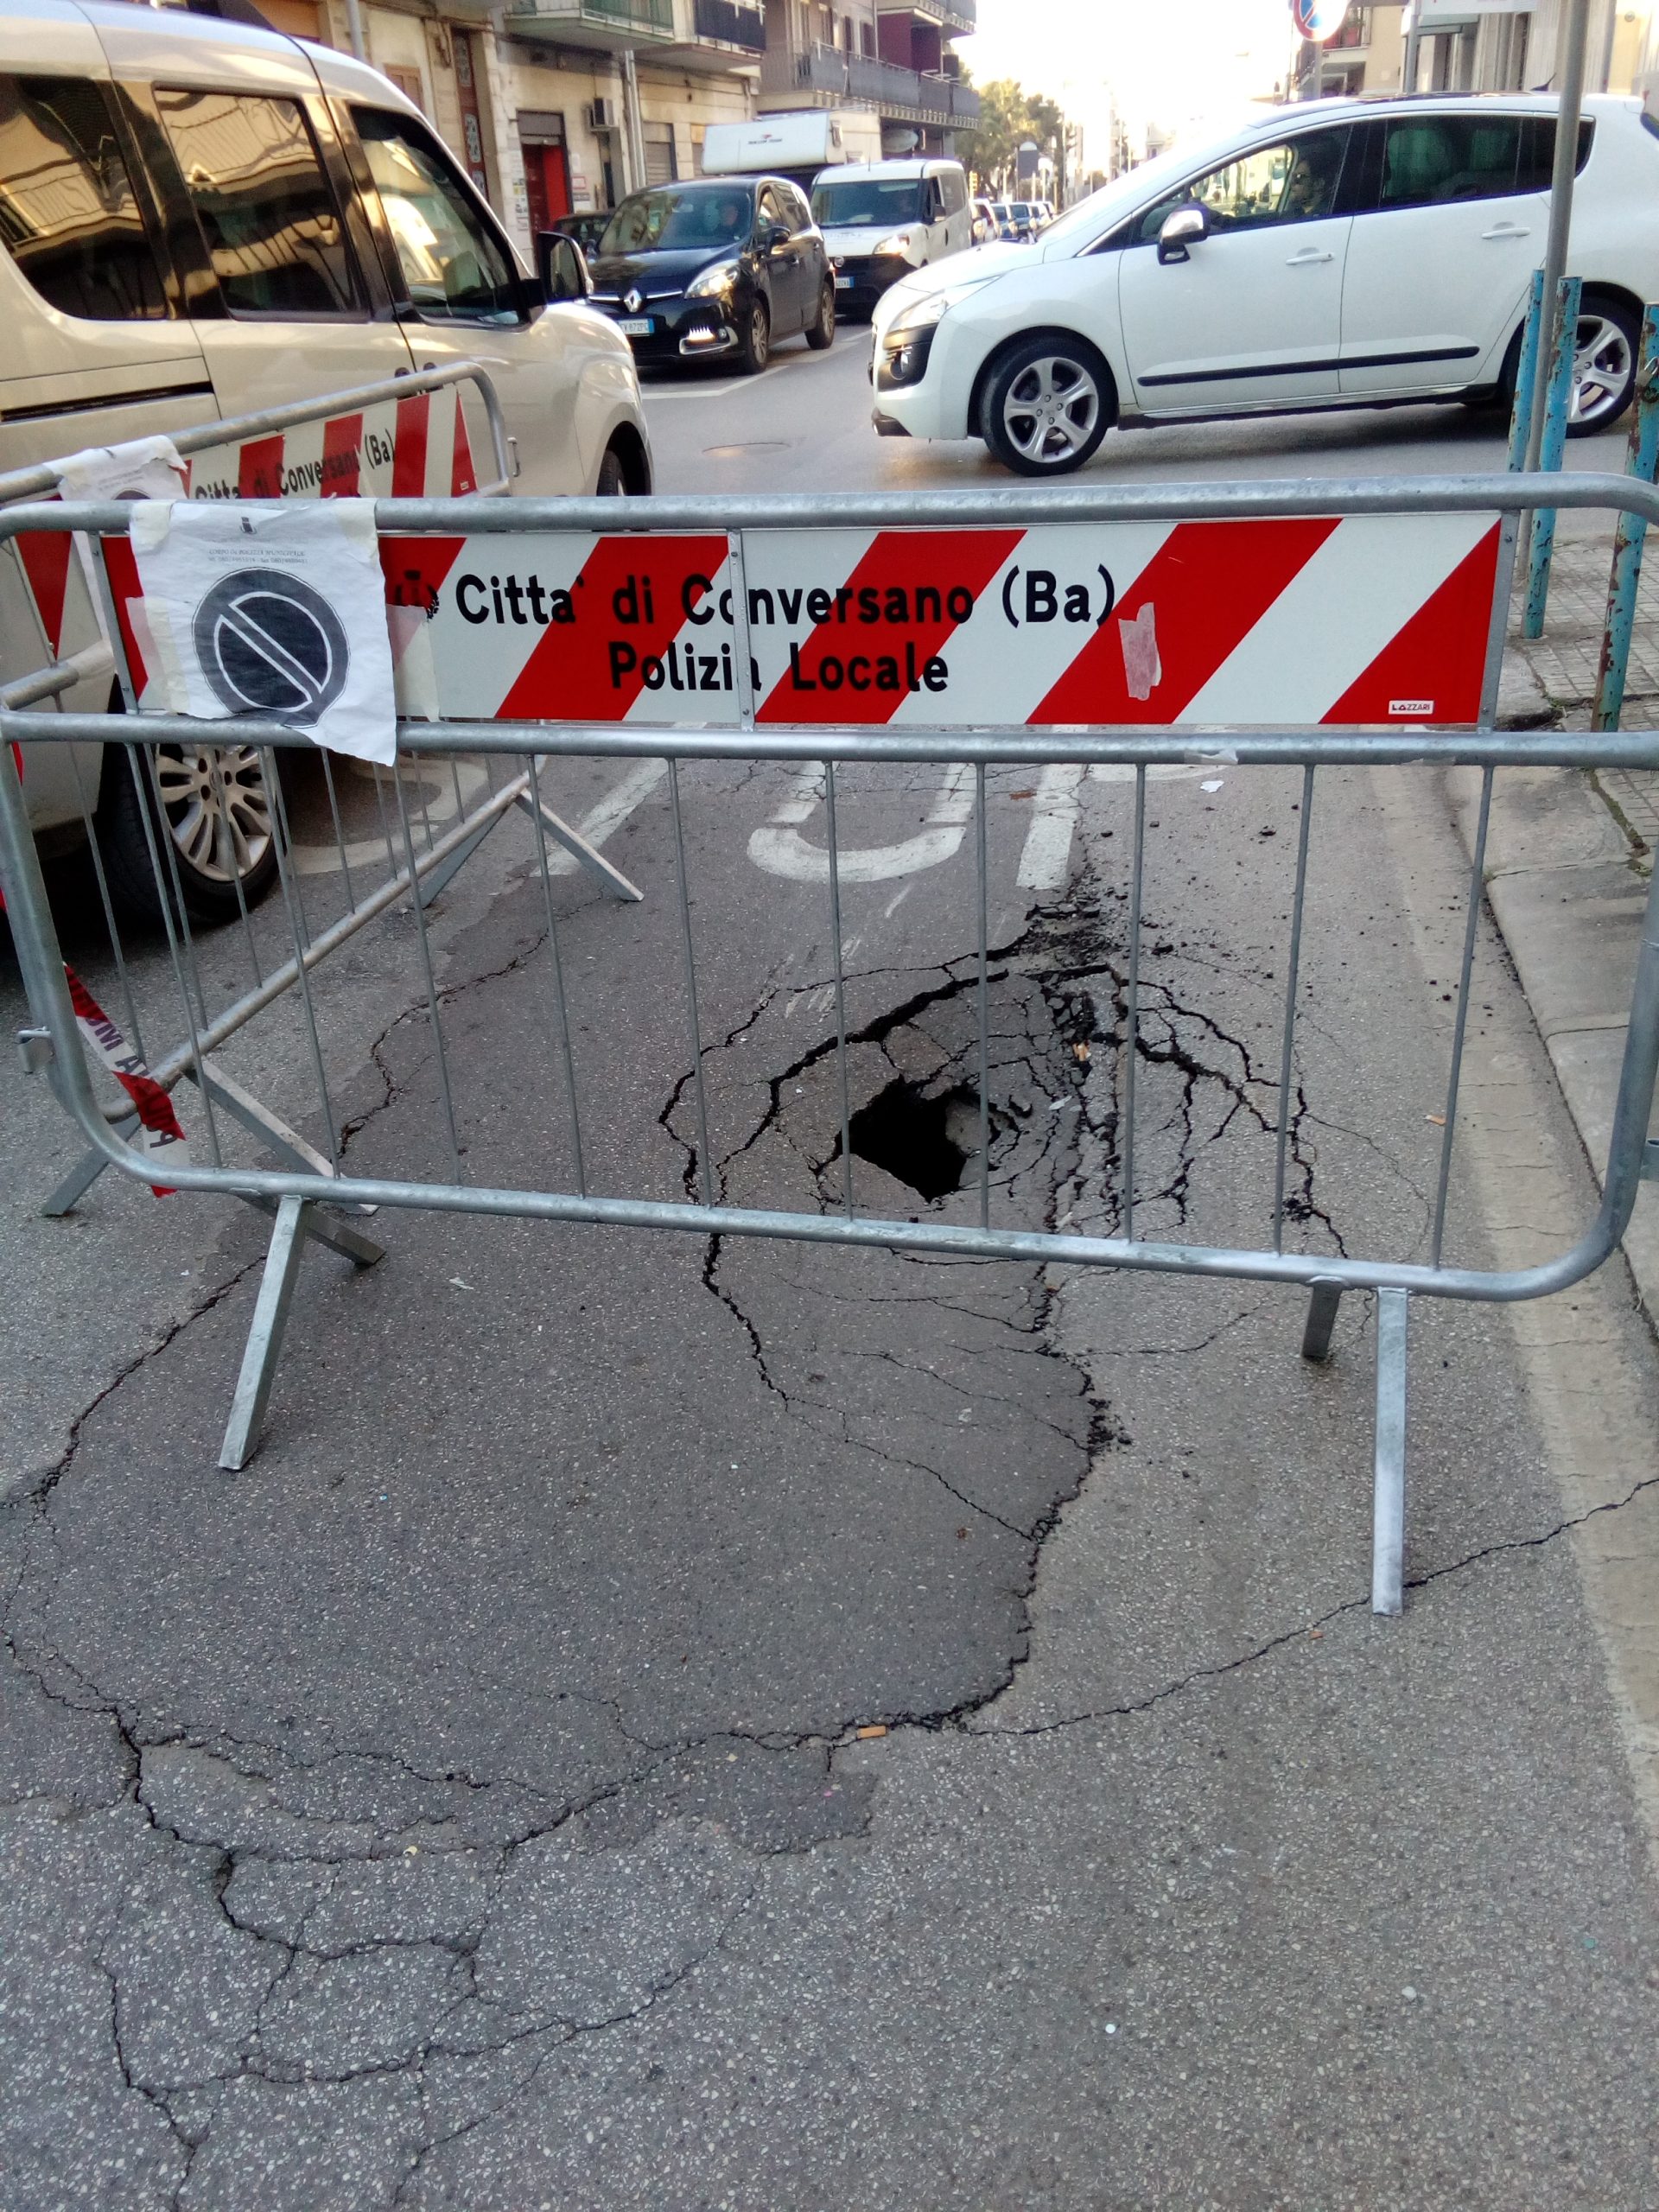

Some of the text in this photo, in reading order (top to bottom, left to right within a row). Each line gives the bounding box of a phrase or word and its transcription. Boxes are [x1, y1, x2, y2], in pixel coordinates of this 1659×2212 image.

[276, 448, 360, 496] Conversan
[364, 429, 395, 470] (Ba)
[455, 563, 1116, 629] Citta' di Conversano (Ba)
[789, 641, 949, 692] Locale
